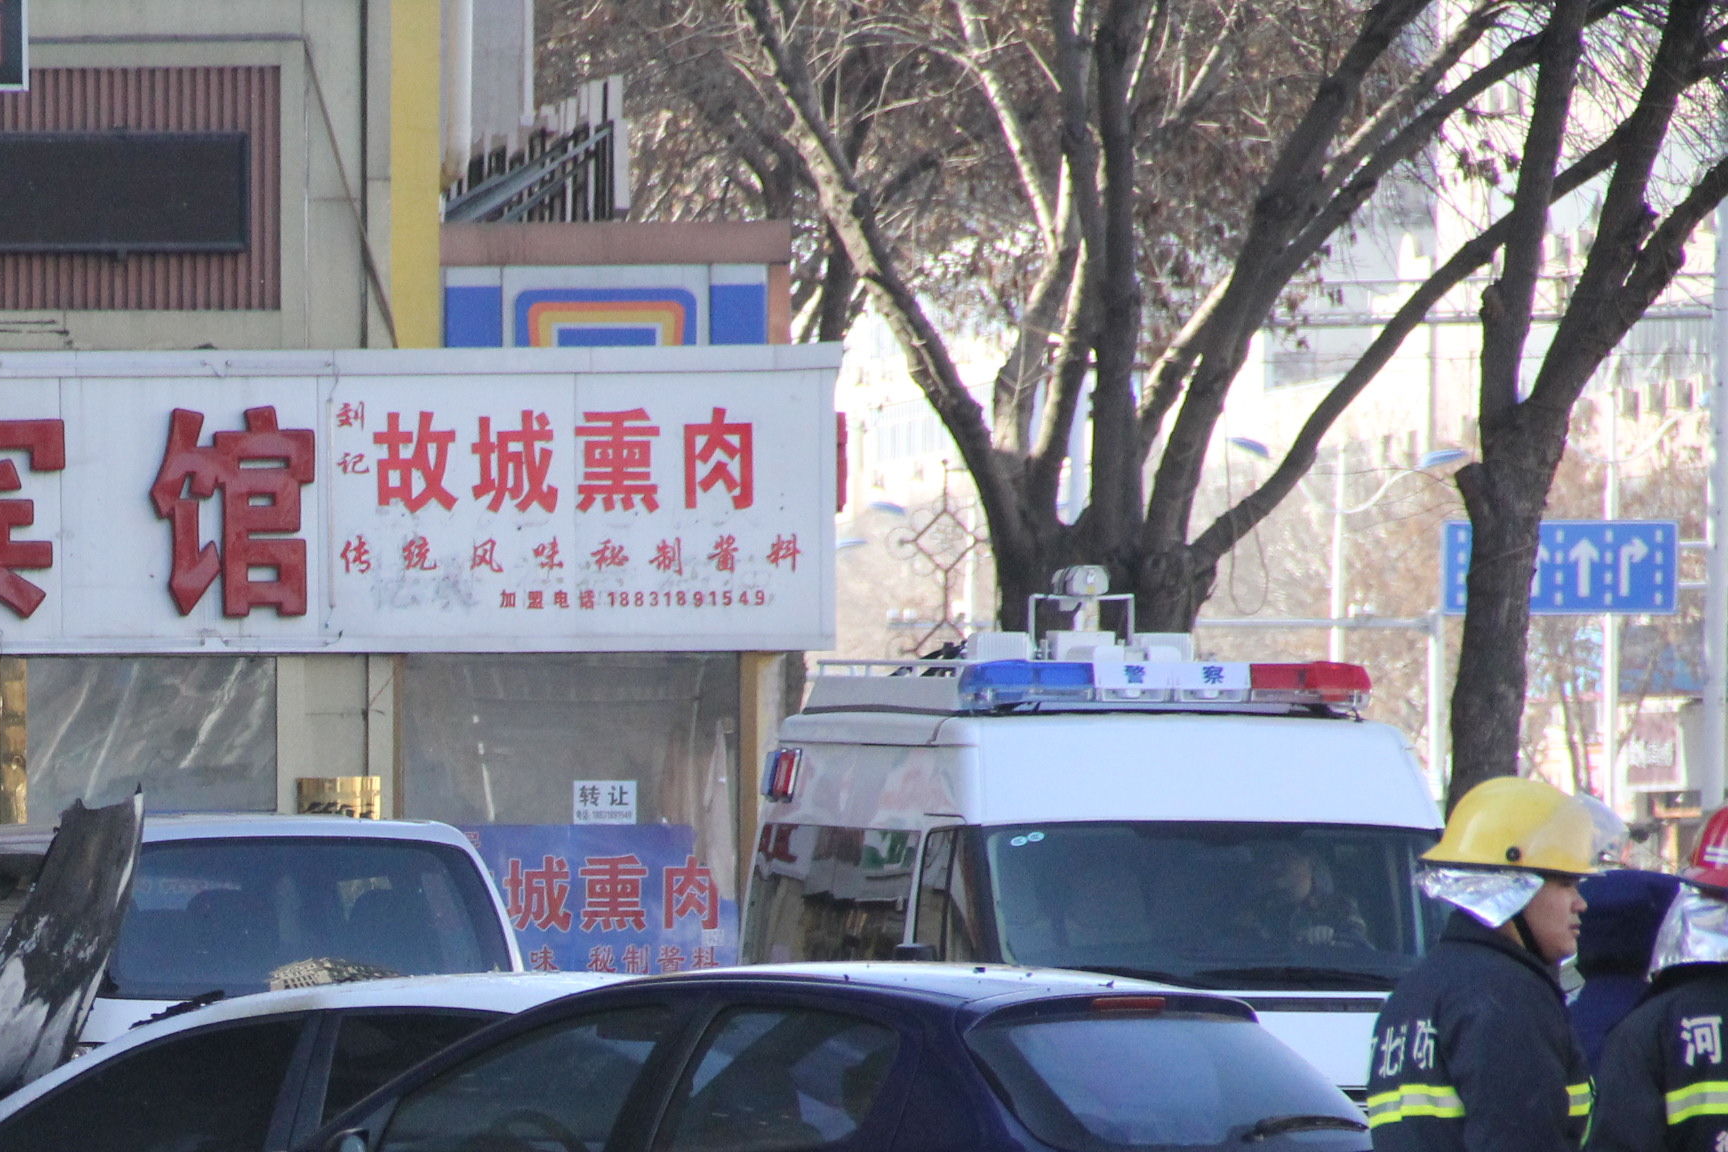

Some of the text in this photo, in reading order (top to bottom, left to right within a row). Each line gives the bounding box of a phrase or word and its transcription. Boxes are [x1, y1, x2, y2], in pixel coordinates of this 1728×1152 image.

[372, 408, 755, 513] 故城熏肉
[339, 533, 803, 577] 传统风味秘制酱料
[499, 588, 766, 610] 加盟电话 18831891549
[1123, 663, 1226, 685] 警察
[579, 785, 629, 807] 转让
[489, 853, 721, 933] 城熏肉
[1680, 1015, 1723, 1067] 河
